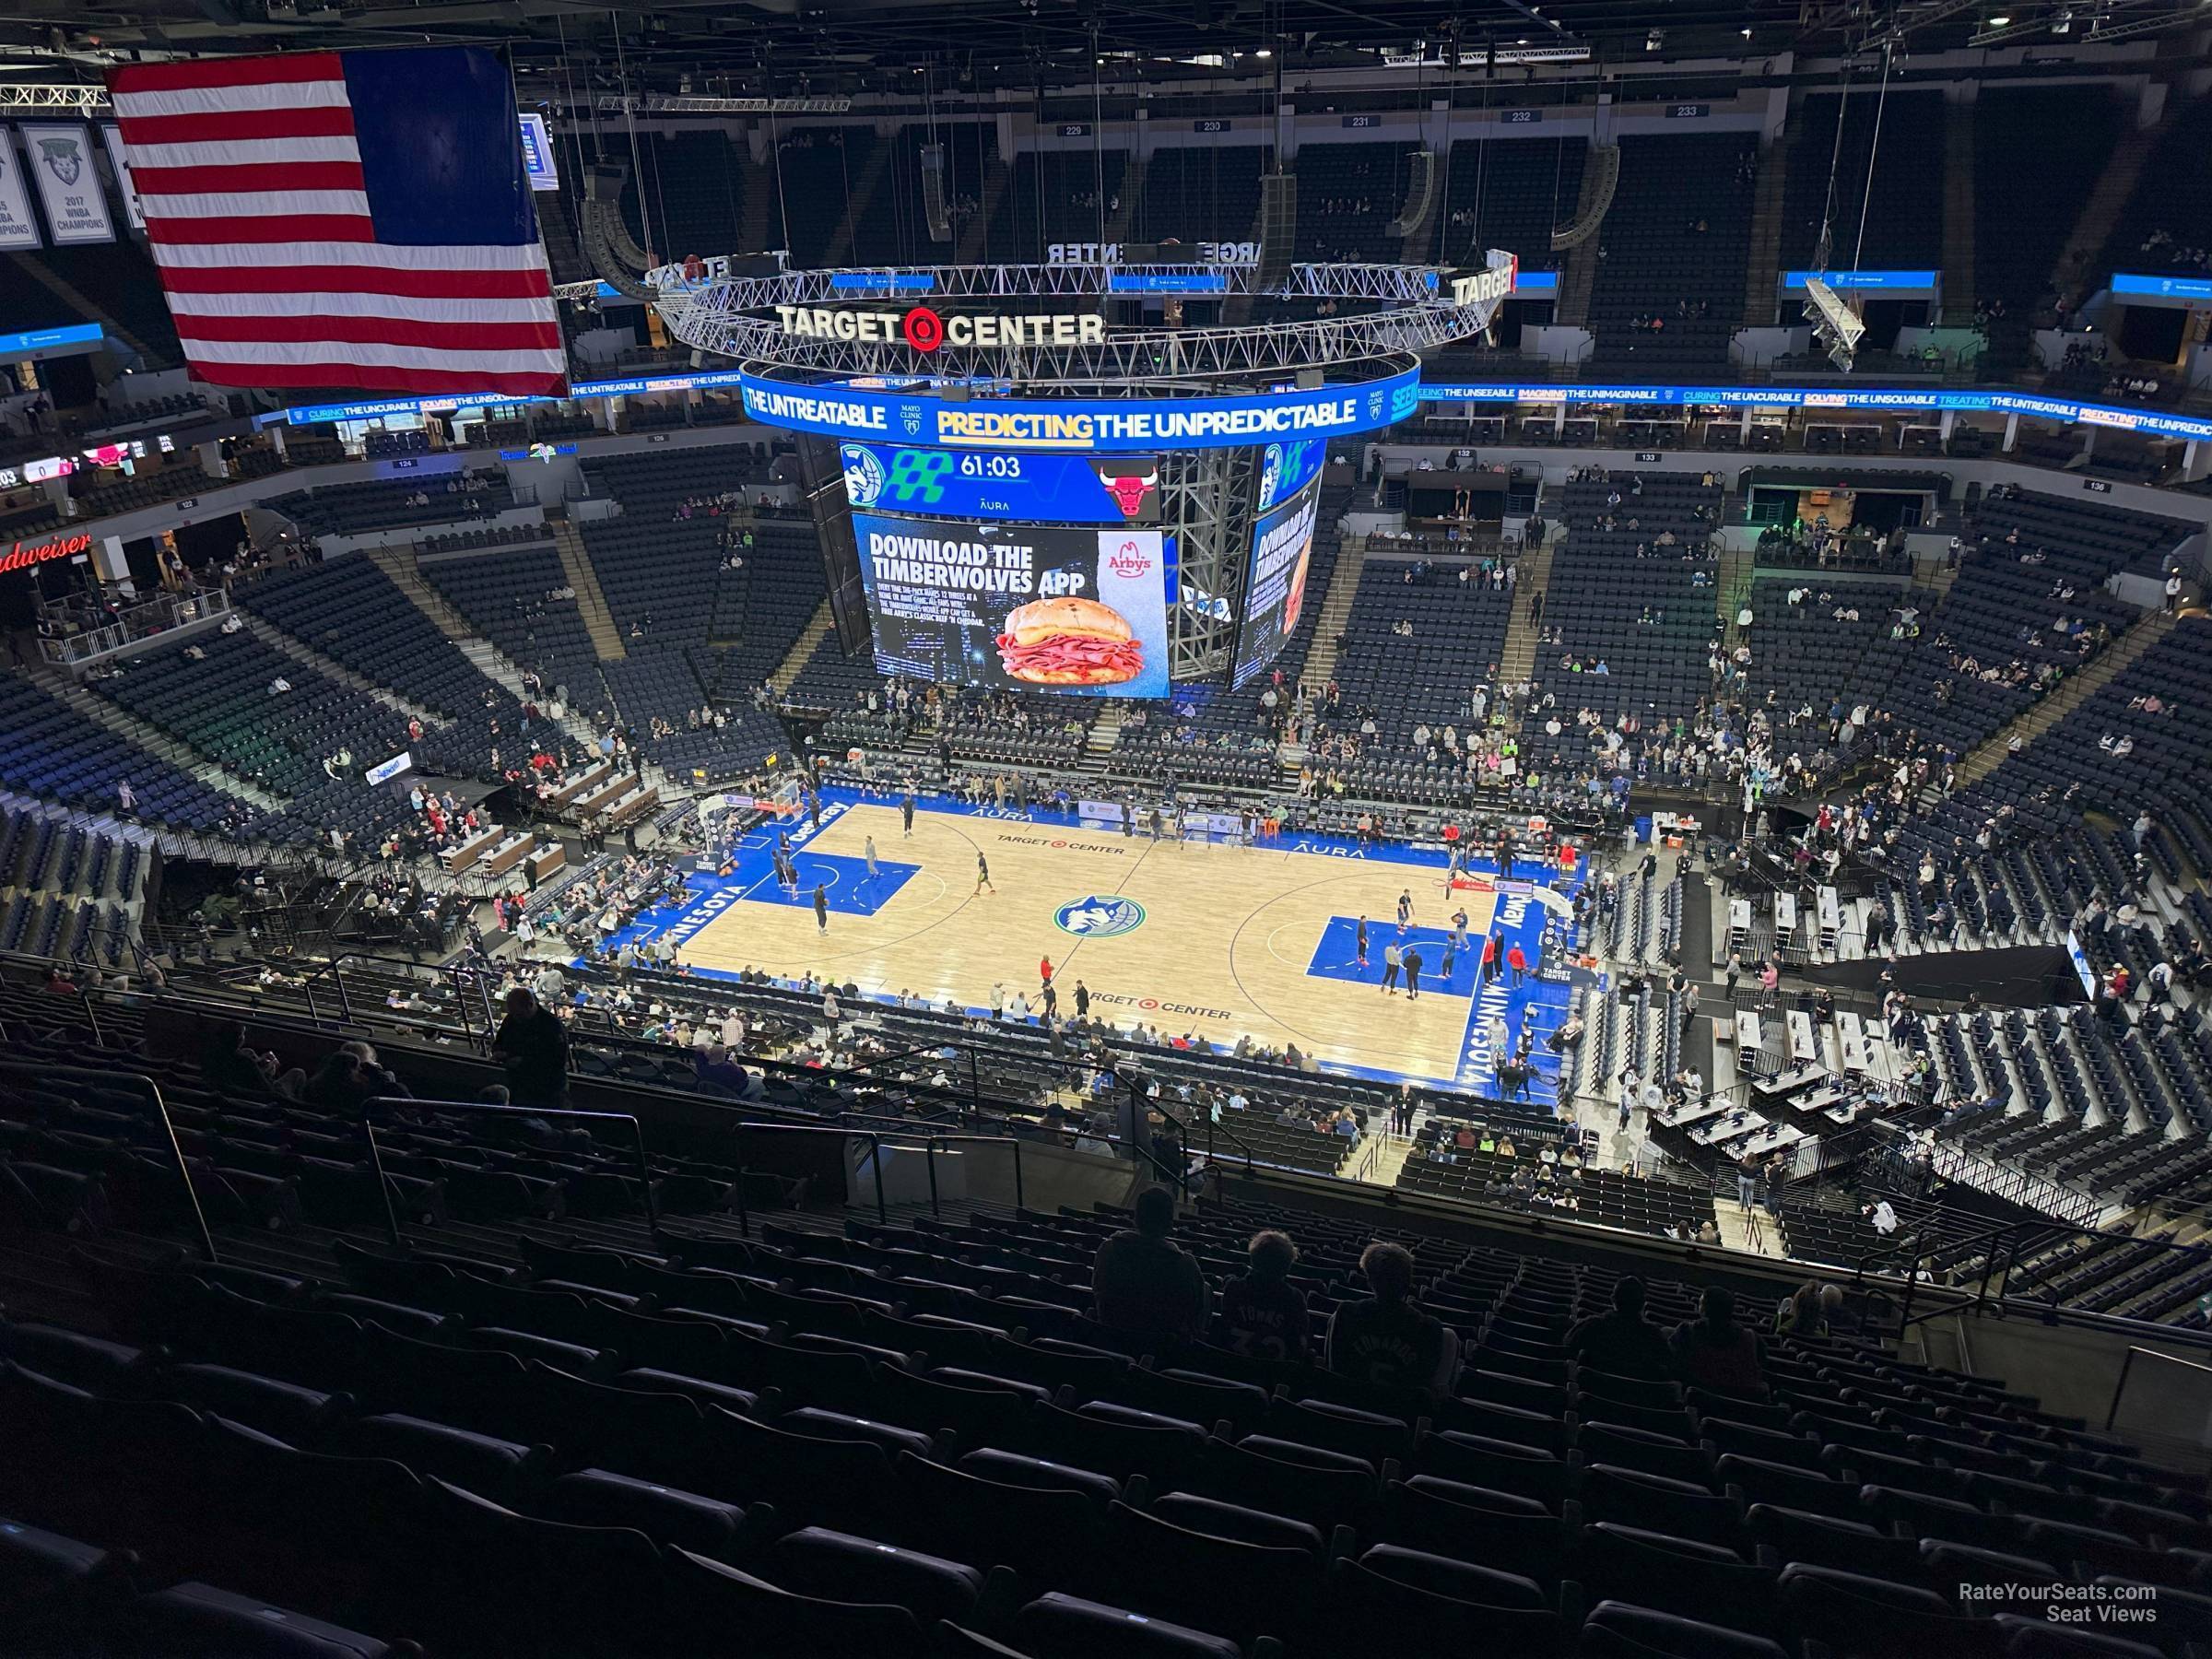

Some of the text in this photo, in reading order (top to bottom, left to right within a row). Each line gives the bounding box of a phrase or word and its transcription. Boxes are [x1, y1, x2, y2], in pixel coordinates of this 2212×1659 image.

[1512, 112, 1531, 121] 232
[1677, 106, 1697, 116] 233
[1204, 122, 1221, 131] 230
[1352, 117, 1369, 126] 231
[1065, 126, 1081, 135] 229
[65, 196, 84, 206] 2017
[65, 208, 90, 218] WNBA
[57, 220, 105, 230] CHAMPIONS
[776, 306, 1103, 345] TARGET CENTER
[571, 382, 588, 394] THE
[588, 382, 643, 394] UNTREATABLE
[646, 378, 692, 389] PREDICTING
[1418, 388, 1443, 396] EEING
[1444, 388, 1463, 396] THE
[1463, 388, 1514, 397] UNSEEABLE
[1519, 390, 1566, 398] IMAGINING
[1587, 391, 1657, 399] UNIMAGINABLE
[1368, 396, 1383, 406] CLINIC
[308, 407, 344, 418] CURING
[344, 404, 363, 415] THE
[363, 402, 417, 414] UNCURABLE
[419, 398, 457, 409] SOLVING
[457, 396, 475, 406] THE
[747, 388, 768, 413] THE
[768, 394, 888, 429] UNTREATABLE
[1683, 392, 1720, 400] CURING
[1722, 393, 1741, 401] THE
[1742, 393, 1801, 402] UNCURABLE
[1804, 394, 1847, 403] SOLVING
[1848, 394, 1868, 403] THE
[1869, 394, 1936, 405] UNSOLVABLE
[1940, 396, 1991, 406] TREATING
[1991, 396, 2012, 406] THE
[2012, 398, 2077, 416] UNTREATABLE
[2079, 407, 2137, 425] PREDICTING
[2137, 418, 2159, 429] THE
[938, 399, 1356, 438] PREDICTING THE UNPREDICTABLE
[40, 466, 46, 477] 0
[960, 455, 1021, 477] 61:03
[869, 533, 1032, 569] DOWNLOAD THE
[873, 557, 1085, 595] TIMBERWOLVES APP
[881, 607, 893, 616] FREE
[913, 612, 935, 621] CLASSIC
[935, 615, 947, 623] BEEF
[959, 609, 971, 618] GET
[997, 835, 1125, 854] TARGET CENTER
[1543, 973, 1571, 982] CENTER
[1544, 968, 1571, 976] TARGET
[1161, 1003, 1231, 1019] CENTER
[1238, 1305, 1286, 1330] TOWNS
